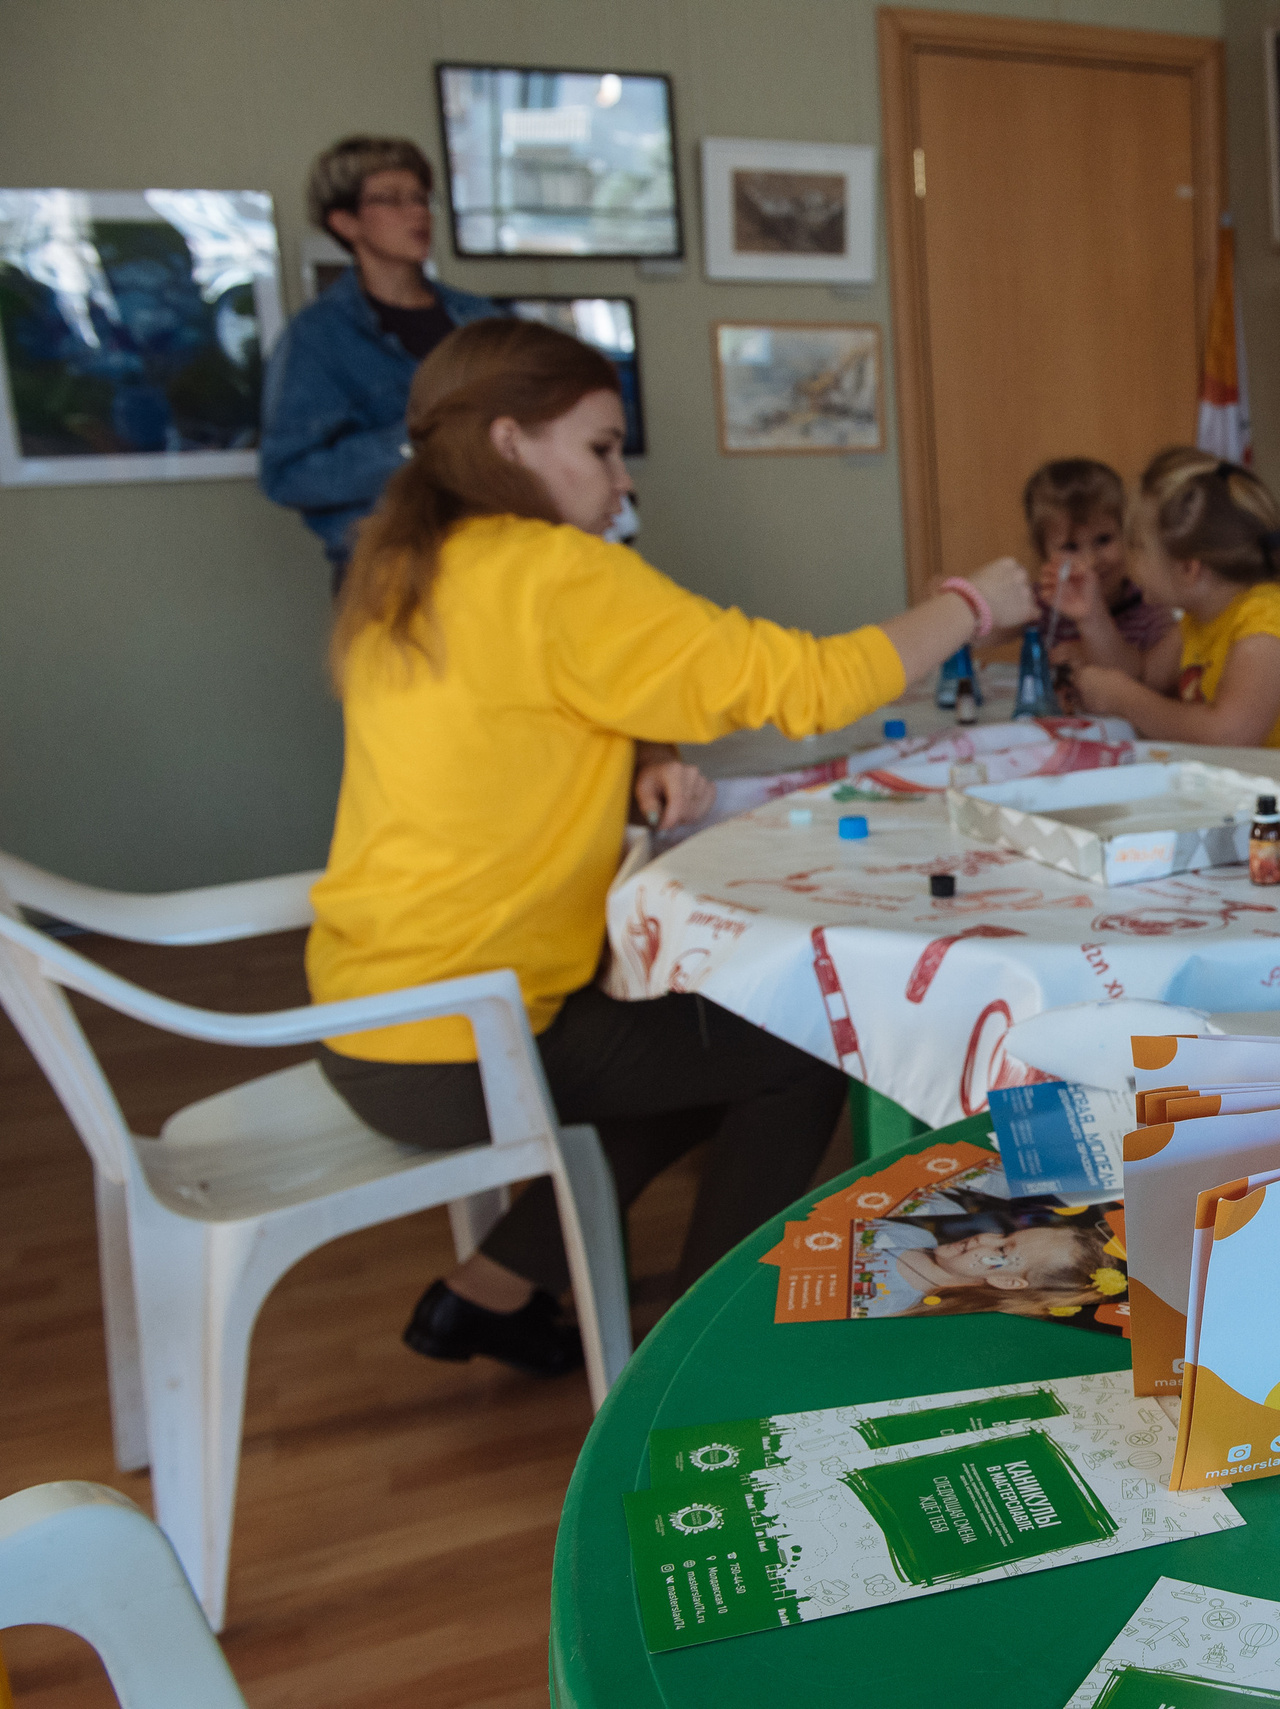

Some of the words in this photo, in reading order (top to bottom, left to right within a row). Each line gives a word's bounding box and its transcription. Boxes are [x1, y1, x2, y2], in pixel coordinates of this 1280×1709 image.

[986, 1465, 1001, 1473] В
[933, 1475, 961, 1521] СЛЕДУЮЩАЯ
[953, 1517, 978, 1544] СМЕНА
[989, 1471, 1035, 1533] МАСТЕРСЛАВЛЕ
[1004, 1460, 1062, 1529] КАНИКУЛЫ
[929, 1512, 950, 1534] ТЕБЯ
[687, 1571, 706, 1624] masterslavl74.ru
[708, 1567, 724, 1606] Молдавская
[718, 1605, 728, 1614] 10
[730, 1563, 746, 1594] 750-44-50
[667, 1586, 685, 1630] masterslavl74
